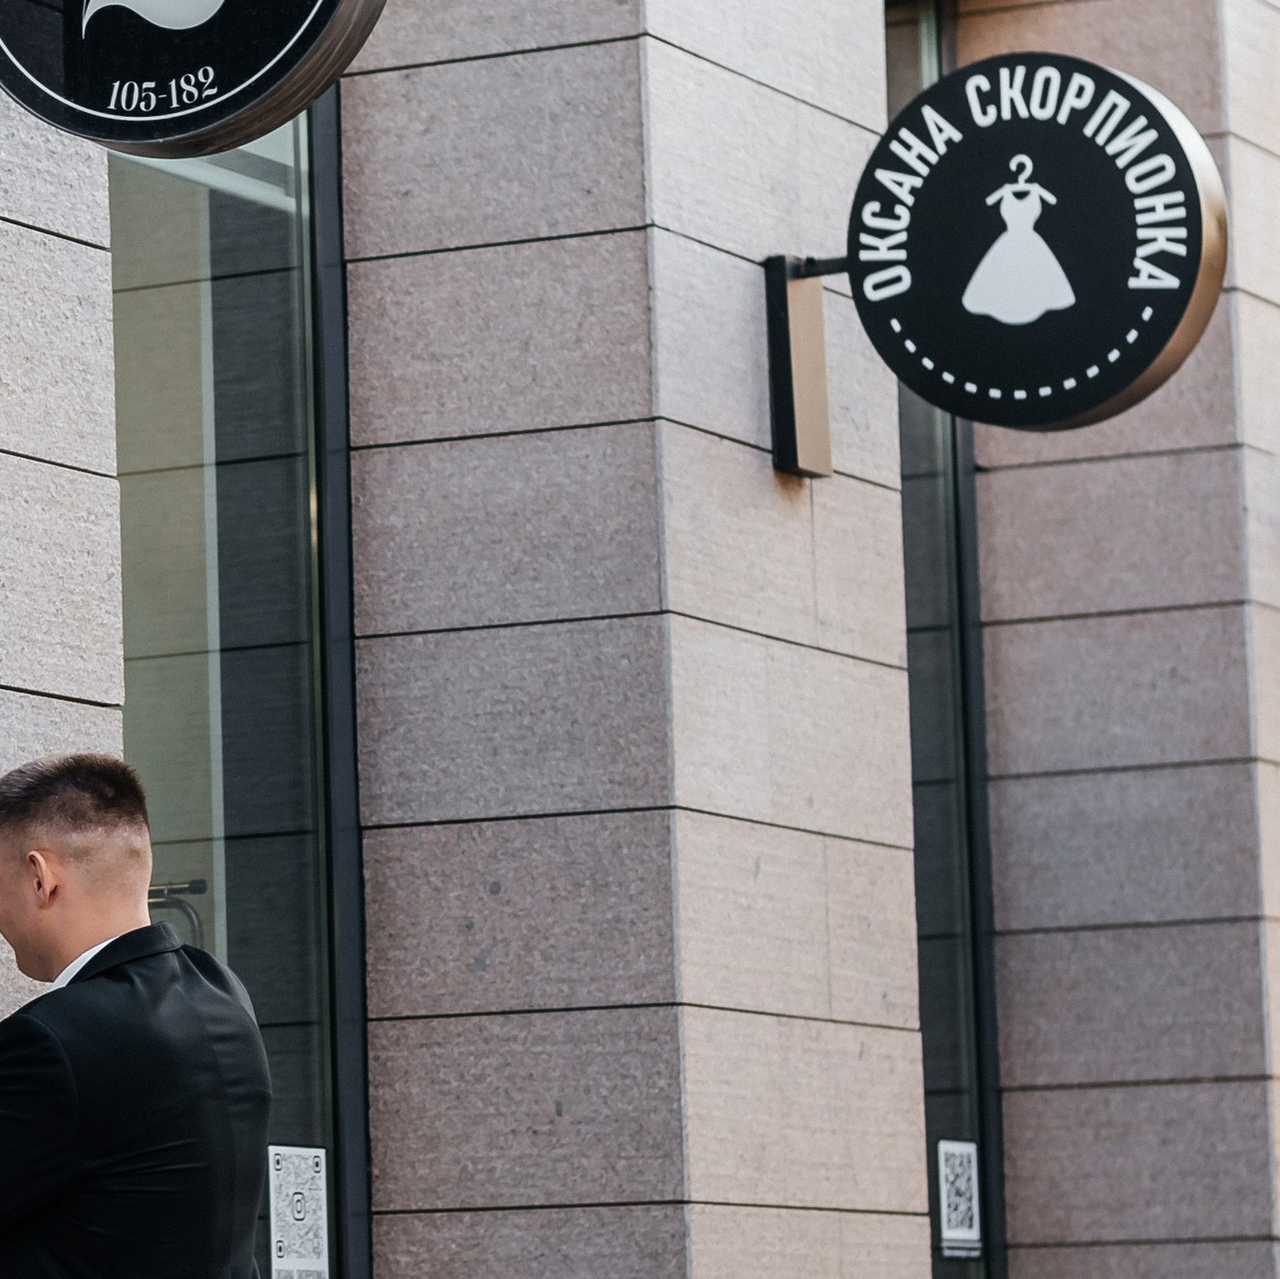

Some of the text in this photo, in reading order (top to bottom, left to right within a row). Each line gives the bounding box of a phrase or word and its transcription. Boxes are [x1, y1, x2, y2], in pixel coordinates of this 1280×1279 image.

[107, 66, 218, 112] 105-182
[858, 65, 1188, 302] ОКСАНА СКОРПИОНКА
